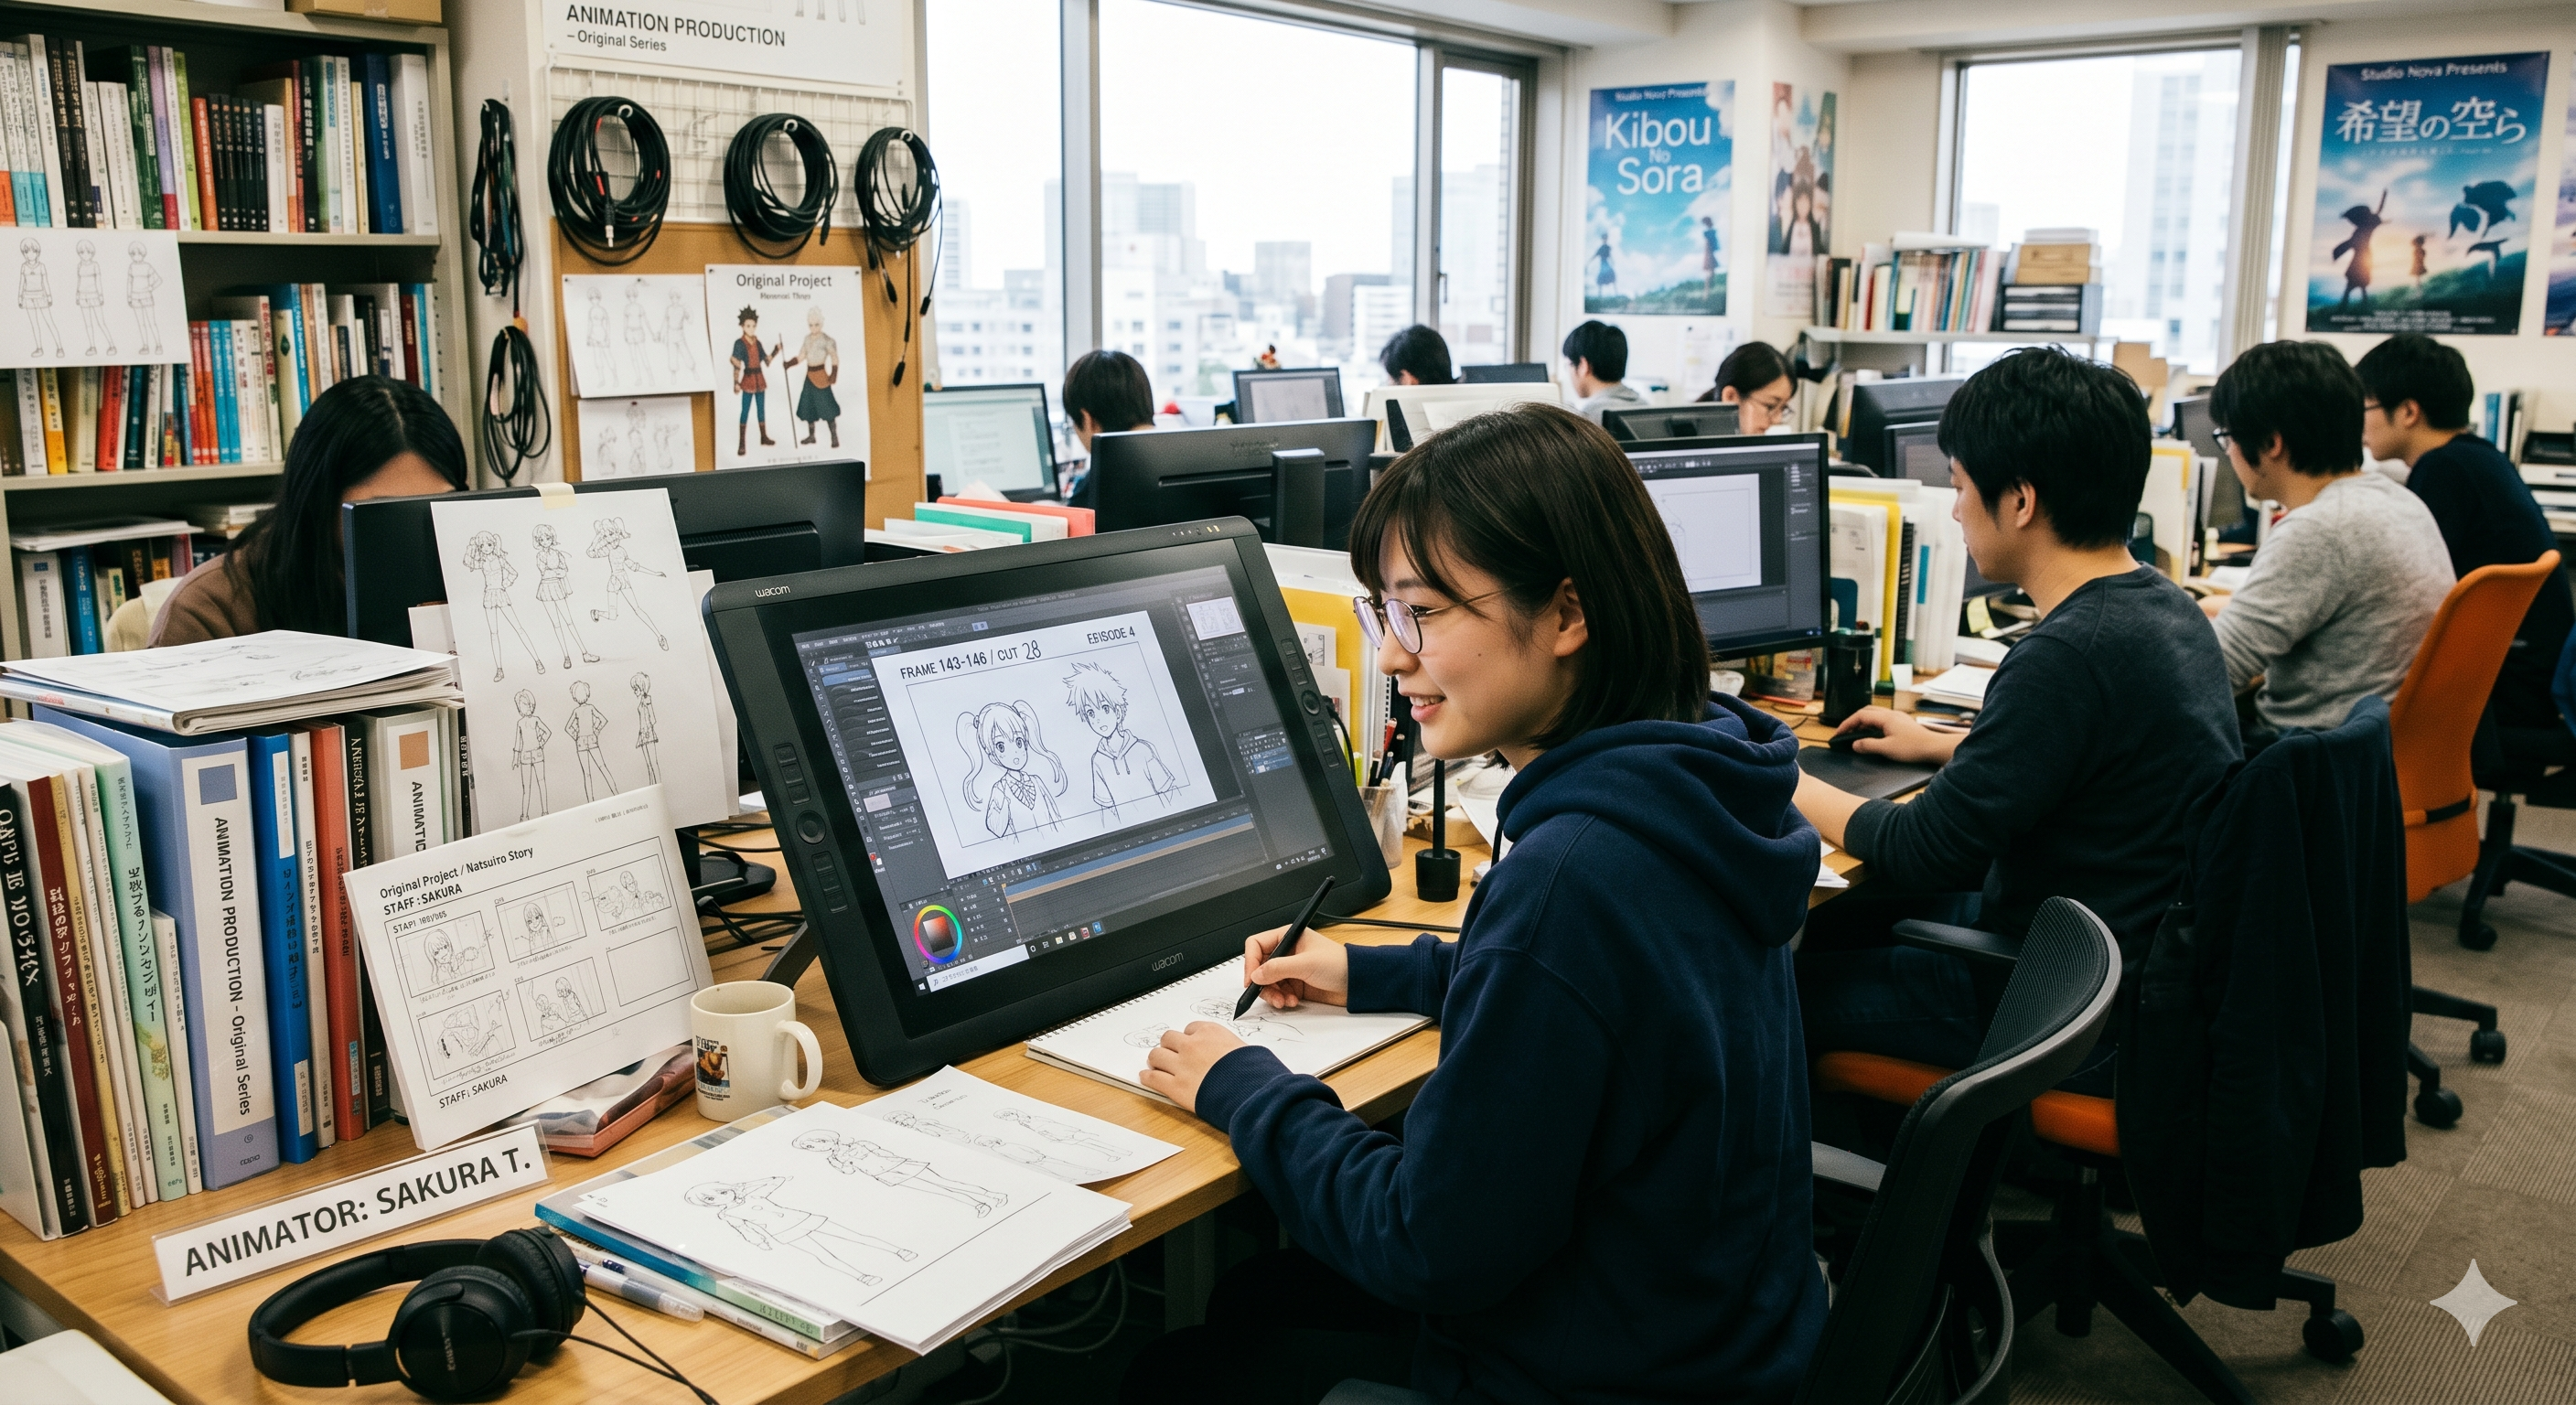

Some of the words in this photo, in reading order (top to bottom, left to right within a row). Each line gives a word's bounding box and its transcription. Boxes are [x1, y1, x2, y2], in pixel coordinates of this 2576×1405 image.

[566, 4, 669, 33] ANIMATION
[674, 17, 786, 47] PRODUCTION
[577, 29, 626, 48] Original
[629, 36, 667, 51] Series
[2361, 65, 2405, 81] Studio
[2445, 60, 2508, 76] Presents
[1605, 111, 1712, 150] Kibou
[1649, 147, 1671, 164] No
[1616, 156, 1703, 195] Sora
[736, 273, 785, 290] Original
[789, 273, 832, 290] Project
[755, 585, 791, 598] wacom
[1129, 626, 1135, 637] 4
[900, 662, 938, 680] FRAME
[939, 651, 987, 672] 143-146
[997, 647, 1018, 661] CUT
[1022, 639, 1042, 660] 28
[214, 817, 234, 902] ANIMATION
[380, 877, 422, 899] Original
[423, 867, 459, 887] Project
[466, 855, 507, 874] Natsuiro
[508, 847, 533, 862] Story
[422, 883, 463, 905] SAKURA
[222, 906, 243, 1003] PRODUCTION
[1152, 952, 1184, 971] wacom
[230, 1015, 249, 1071] Original
[471, 1074, 509, 1096] SAKURA
[185, 1198, 368, 1277] ANIMATOR:
[376, 1155, 499, 1215] SAKURA
[501, 1146, 531, 1180] T.
